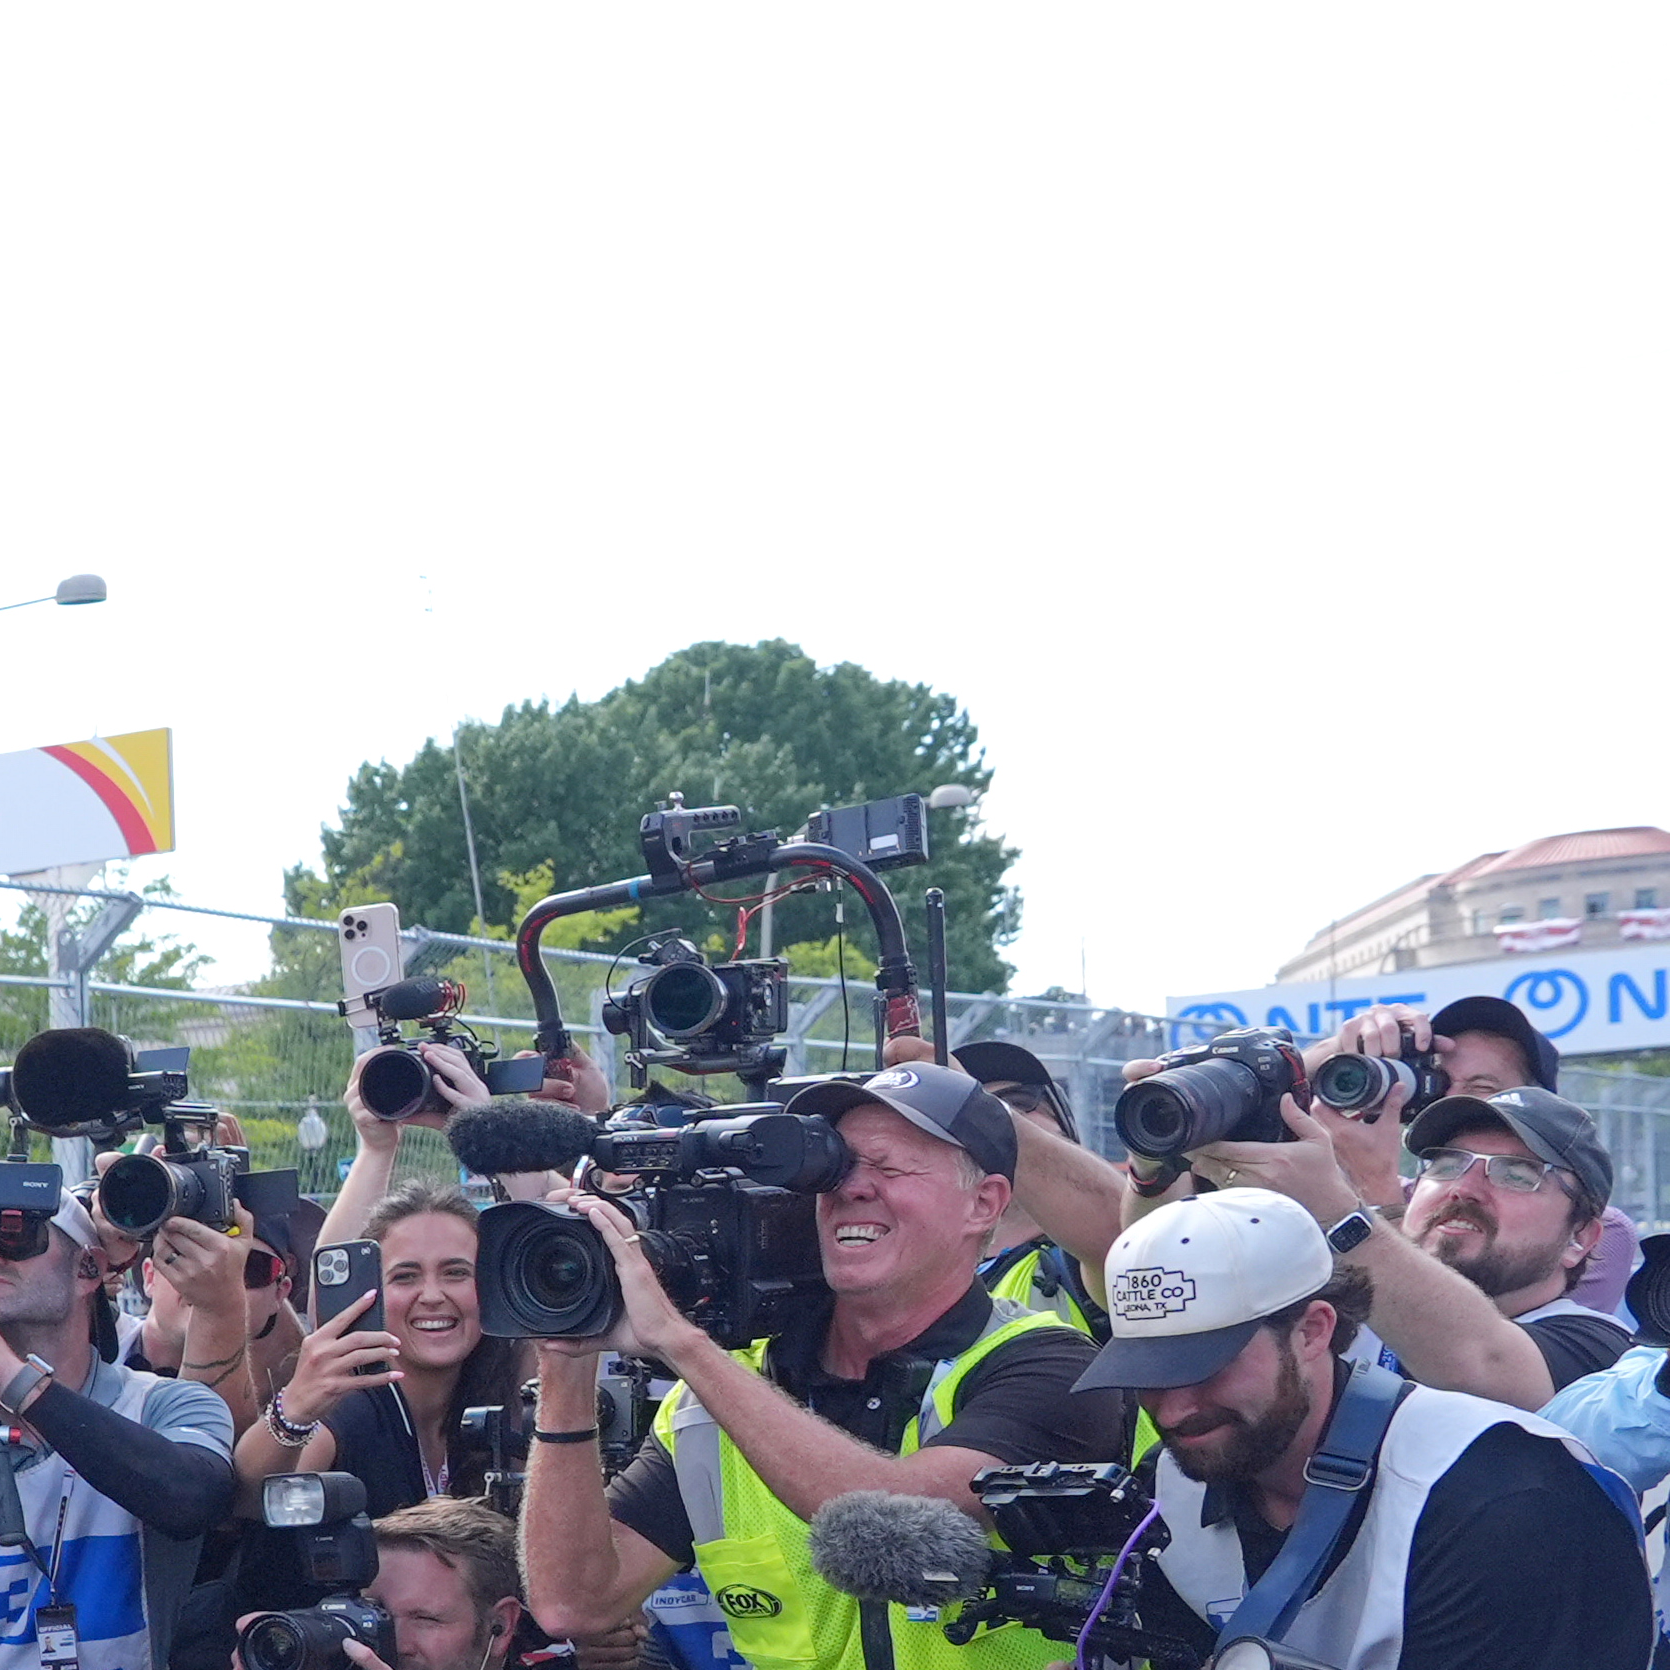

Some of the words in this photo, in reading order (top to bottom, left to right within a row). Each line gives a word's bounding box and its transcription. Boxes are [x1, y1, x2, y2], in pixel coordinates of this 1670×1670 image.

[1116, 1288, 1157, 1302] CATTLE
[1160, 1286, 1184, 1299] CO
[1153, 1301, 1167, 1311] TX
[654, 1593, 696, 1605] INDYCAR
[724, 1593, 766, 1610] FOX
